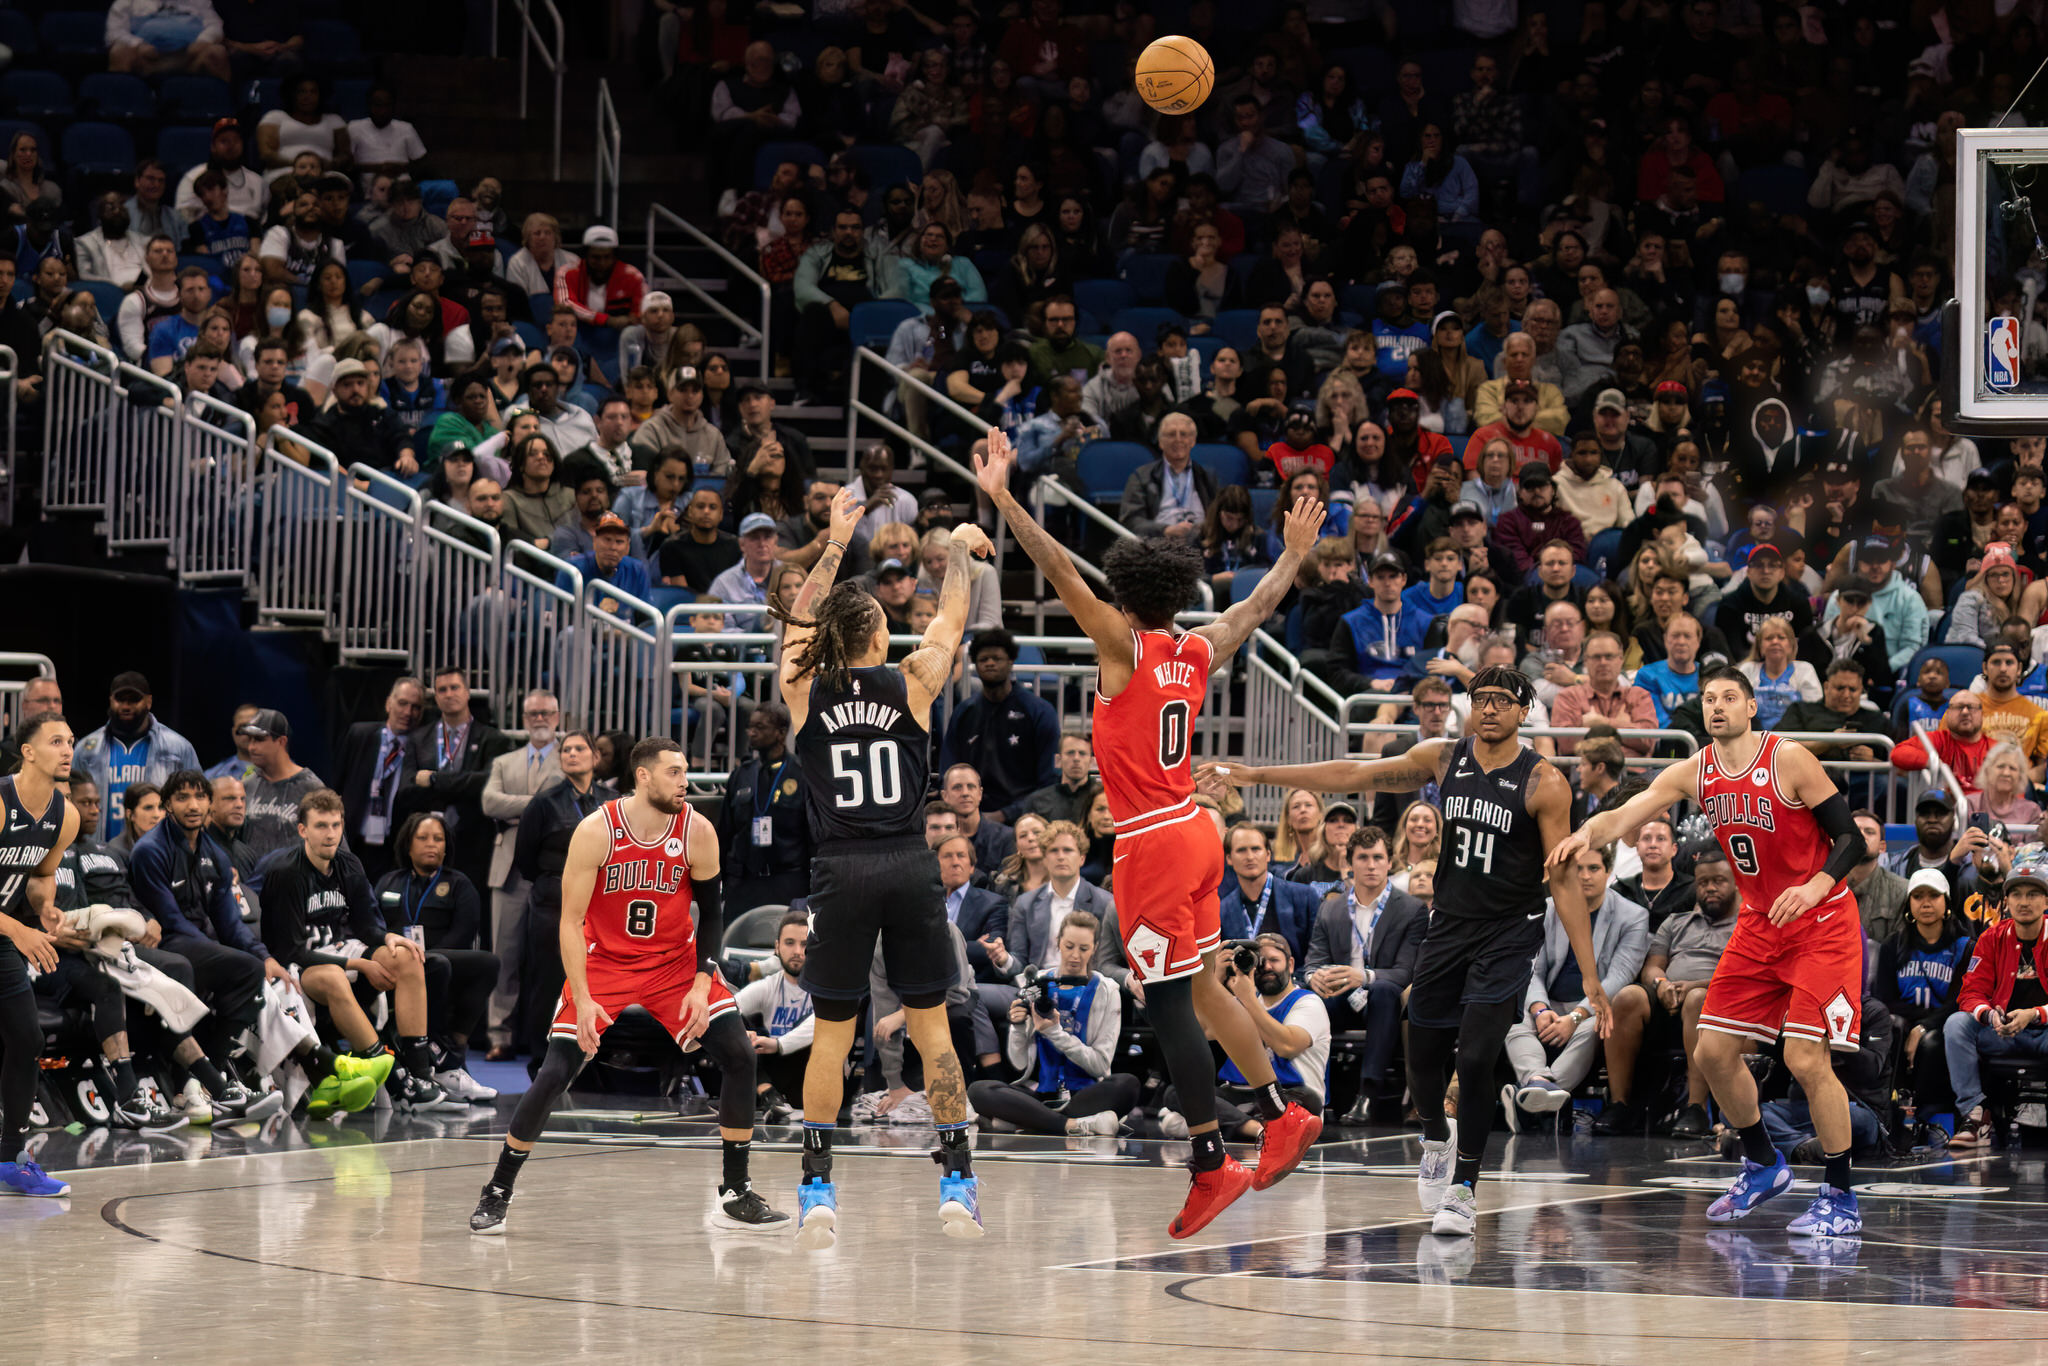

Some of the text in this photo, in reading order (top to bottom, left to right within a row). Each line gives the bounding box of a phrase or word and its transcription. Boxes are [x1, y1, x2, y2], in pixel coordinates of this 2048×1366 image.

[1993, 371, 2008, 383] NBA
[1153, 661, 1195, 688] WHITE
[820, 701, 902, 734] ANTHONY
[1159, 699, 1190, 770] 0
[830, 740, 901, 808] 50
[1445, 796, 1513, 835] ORLANDO
[1704, 793, 1776, 833] BULLS
[615, 827, 625, 839] 6
[1454, 825, 1496, 874] 34
[1728, 833, 1760, 876] 9
[603, 859, 686, 895] BULLS
[625, 899, 657, 939] 8
